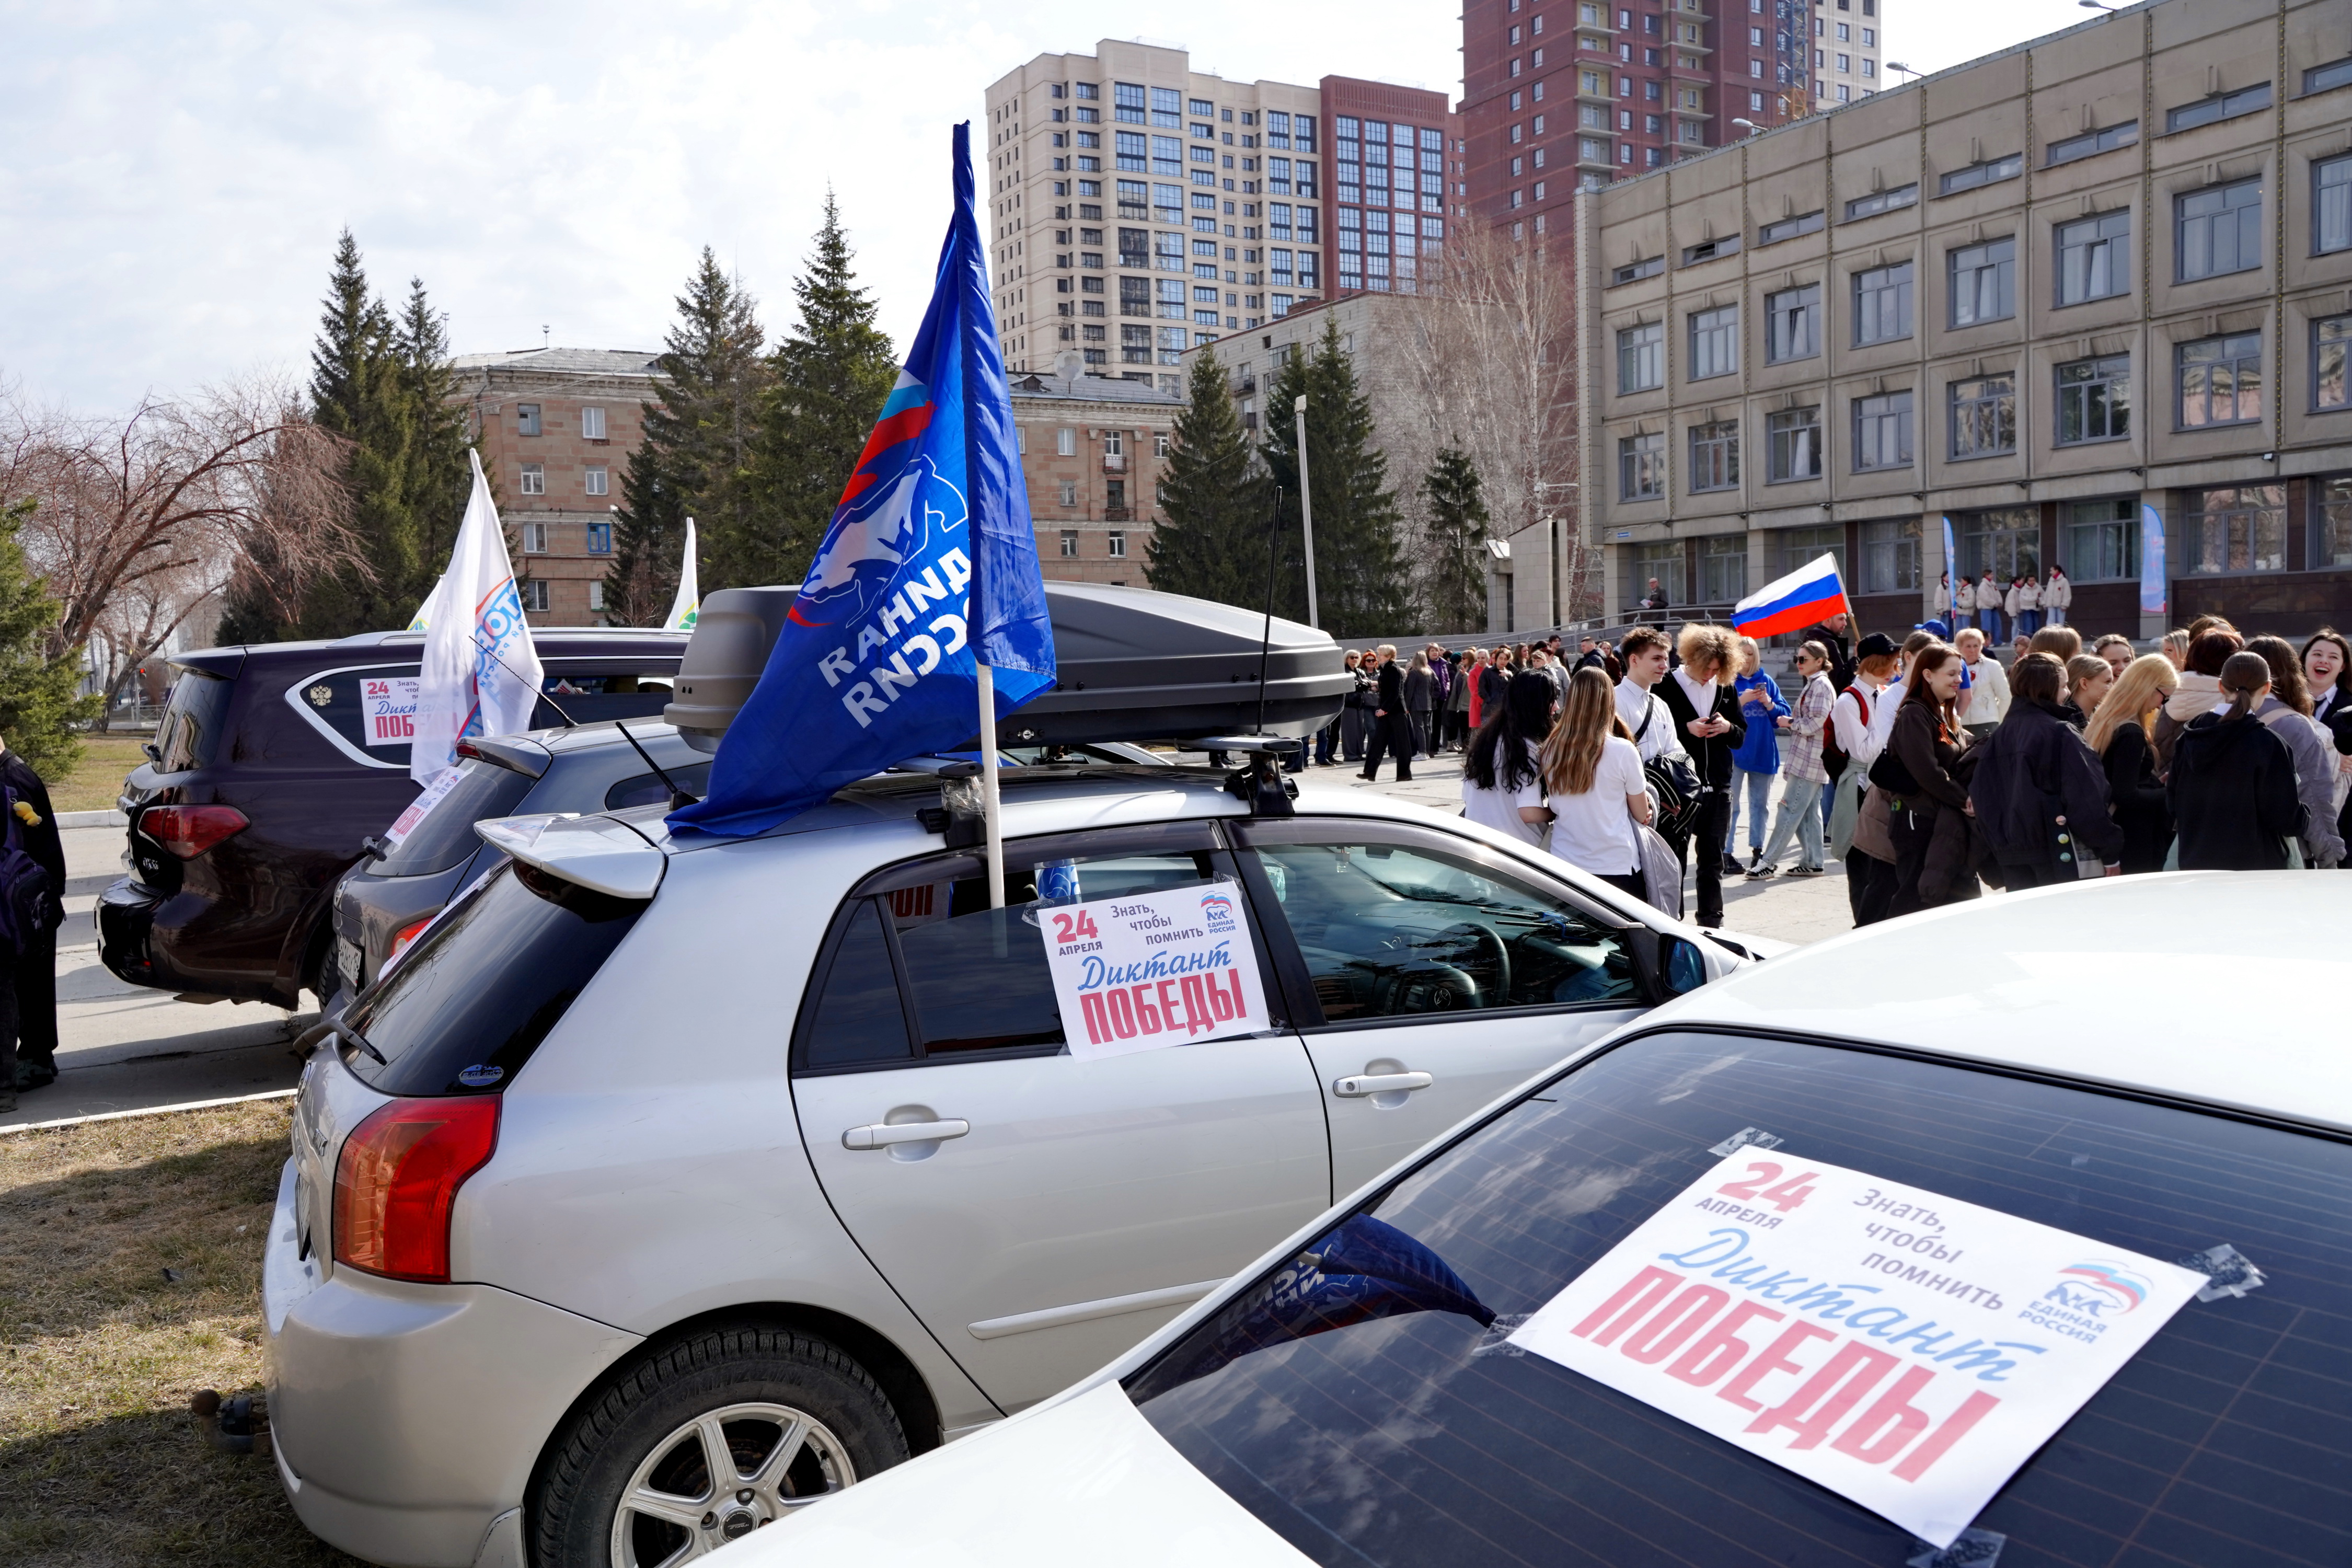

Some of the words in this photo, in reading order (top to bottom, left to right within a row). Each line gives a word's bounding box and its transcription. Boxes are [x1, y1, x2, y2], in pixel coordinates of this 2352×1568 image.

[367, 682, 389, 695] 24
[375, 714, 414, 738] ПОБ
[1052, 910, 1098, 943] 24
[1111, 904, 1155, 918] Знать,
[1129, 915, 1172, 931] чтобы
[1207, 919, 1235, 928] ЕДИНАЯ
[1146, 927, 1204, 945] помнить
[1209, 925, 1236, 934] РОССИЯ
[1059, 941, 1103, 956] АПРЕЛЯ
[1077, 940, 1231, 991] Диктант
[1080, 968, 1247, 1045] ПОБЕДЫ
[1715, 1161, 1821, 1214] 24
[1694, 1196, 1784, 1231] АПРЕЛЯ
[1853, 1187, 1948, 1235] Знать,
[1864, 1219, 1964, 1265] чтобы
[1860, 1251, 2004, 1312] помнить
[1658, 1227, 2049, 1383] Диктант
[2027, 1299, 2108, 1335] ЕДИНАЯ
[2017, 1309, 2098, 1345] РОССИЯ
[1569, 1264, 2001, 1484] ПОБЕДЫ
